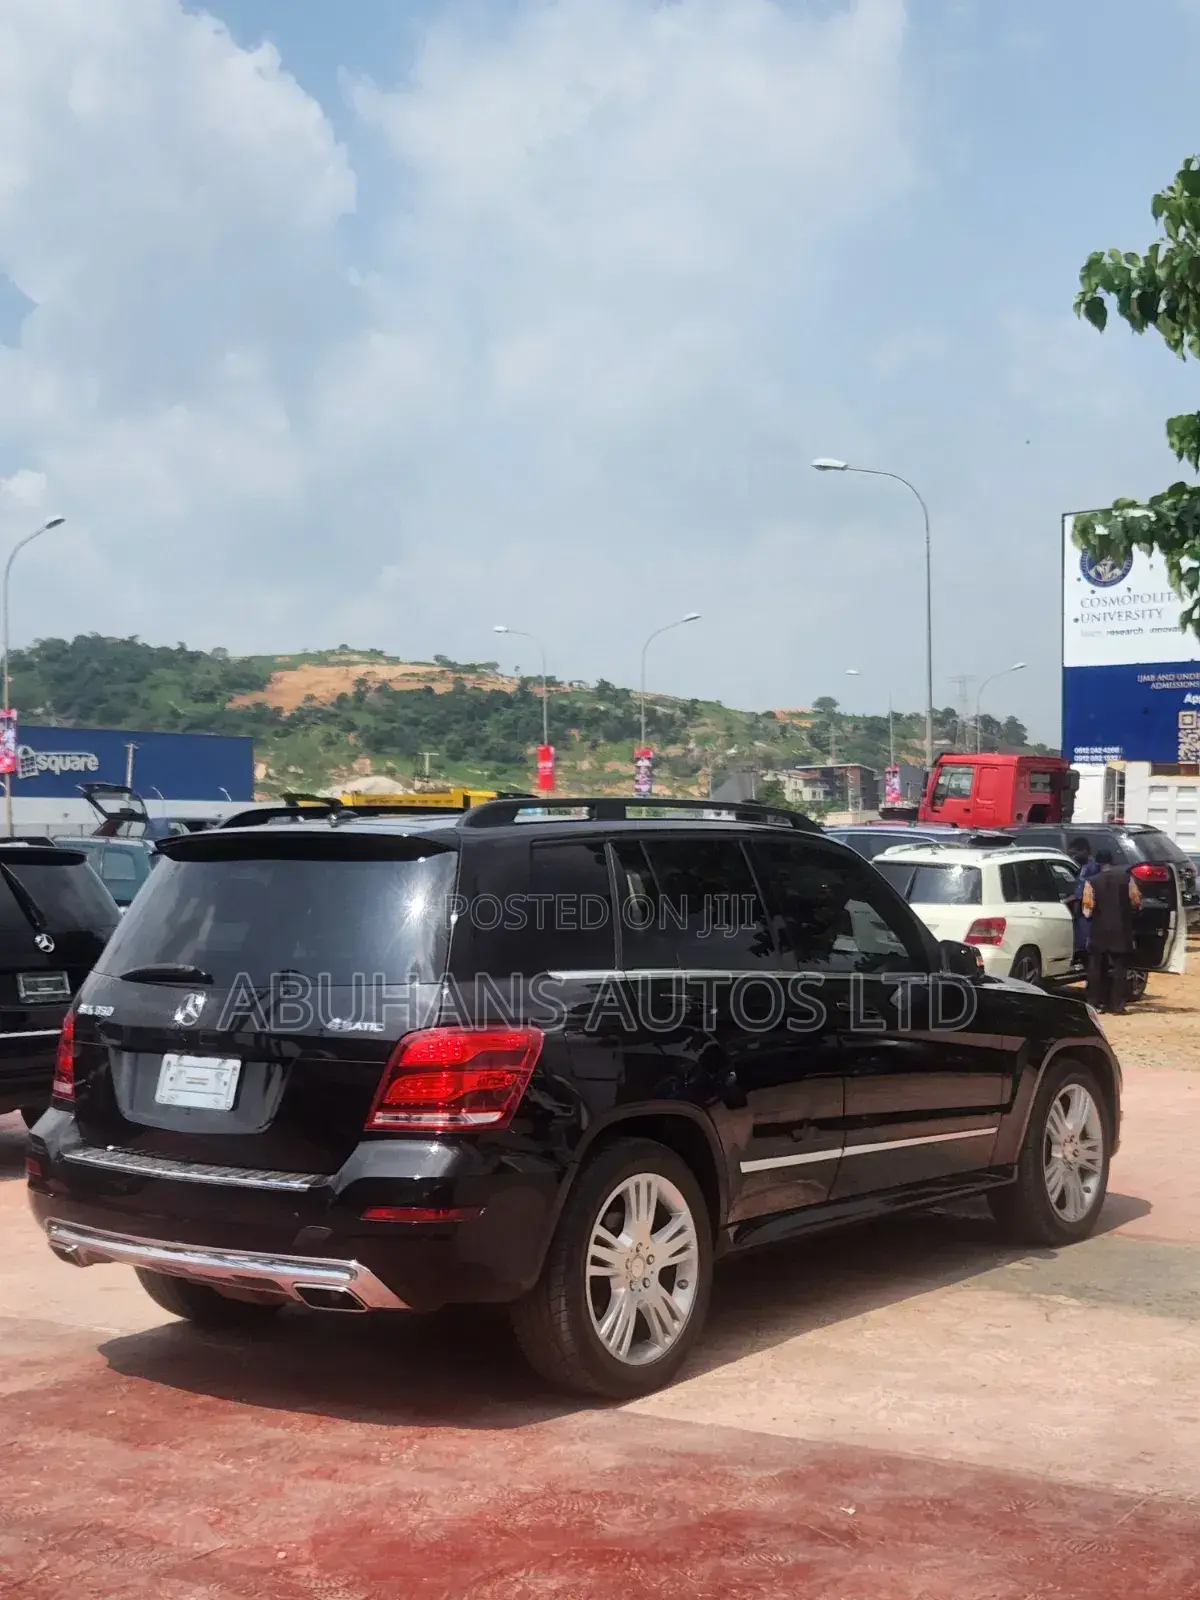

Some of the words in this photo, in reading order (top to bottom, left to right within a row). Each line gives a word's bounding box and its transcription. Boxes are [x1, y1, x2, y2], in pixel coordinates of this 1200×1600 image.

[1080, 607, 1163, 624] UNIVERSITY
[1106, 626, 1144, 636] research
[1157, 673, 1176, 681] AND
[1151, 681, 1200, 690] ADMISSIONS
[36, 754, 99, 776] square
